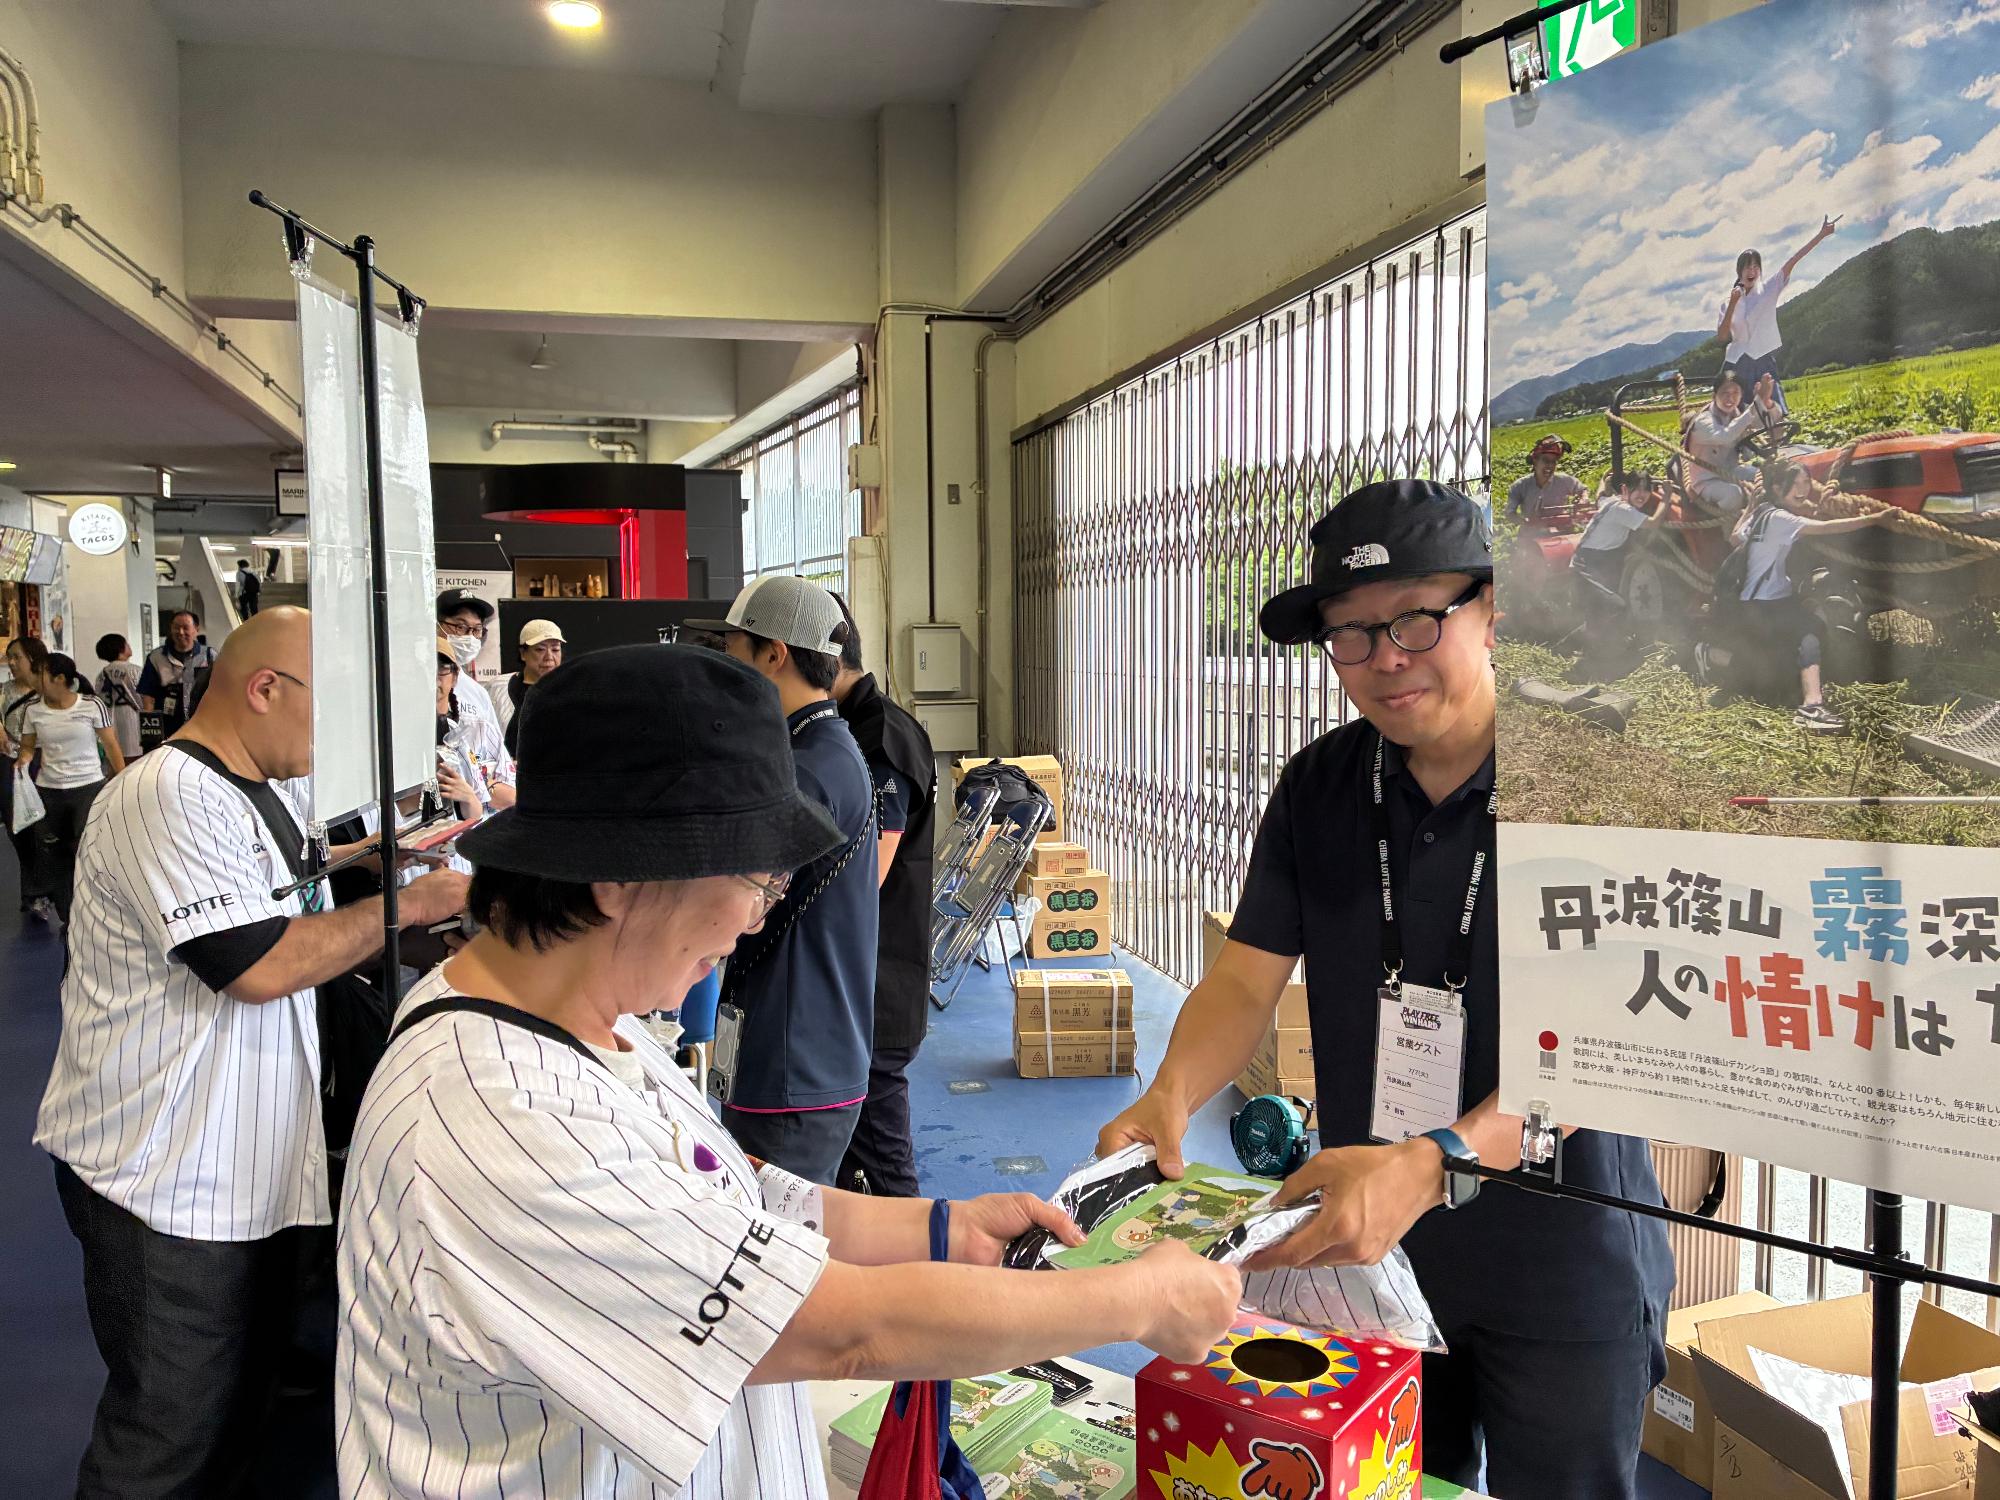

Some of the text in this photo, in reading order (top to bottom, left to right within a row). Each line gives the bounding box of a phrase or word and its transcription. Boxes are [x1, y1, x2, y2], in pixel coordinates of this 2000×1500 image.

[81, 534, 115, 545] TACOS
[1342, 552, 1371, 566] NORTH
[1352, 545, 1371, 556] THE
[1350, 559, 1372, 570] FACE
[436, 577, 487, 587] E KITCHEN
[142, 717, 160, 727] 入口
[1373, 772, 1383, 805] MARINES
[1379, 839, 1394, 922] CHIBA LOTTE MARINES
[1050, 891, 1095, 910] 黒豆茶
[1460, 851, 1486, 935] CHIBA LOTTE MARINES
[161, 893, 234, 926] LOTTE
[1539, 867, 1782, 950] 丹波篠山
[1050, 931, 1095, 950] 黒豆茶
[1402, 1006, 1421, 1018] PLAY
[1625, 949, 1955, 1056] 人の情けは
[1402, 1014, 1419, 1025] WIN
[1396, 1036, 1441, 1057] 営業ゲスト
[679, 1218, 775, 1346] LOTTE
